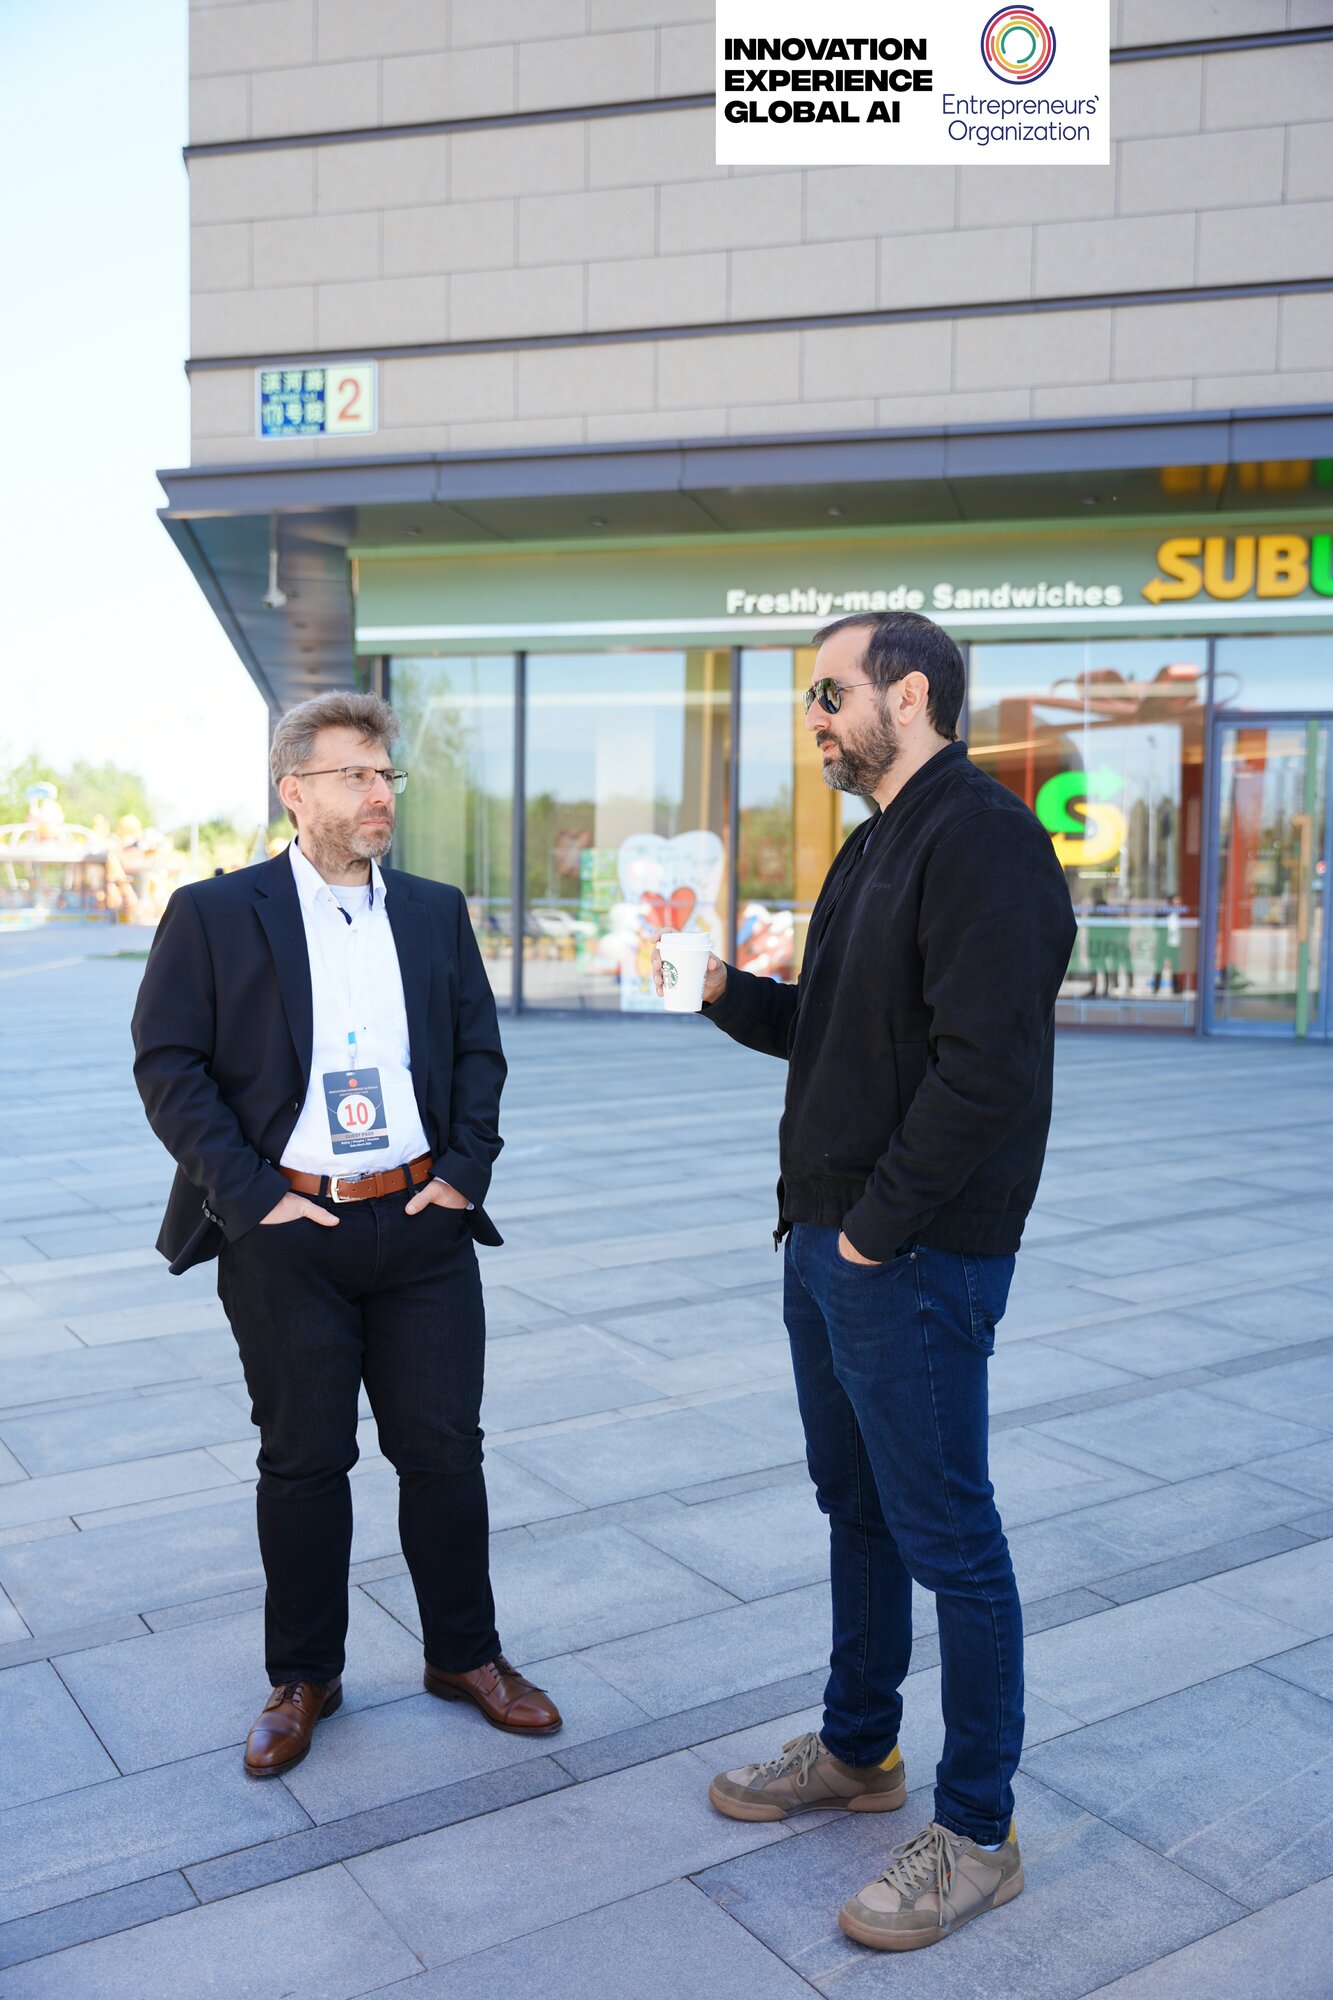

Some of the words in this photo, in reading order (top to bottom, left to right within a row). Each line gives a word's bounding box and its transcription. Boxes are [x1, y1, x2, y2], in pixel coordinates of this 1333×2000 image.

[338, 378, 361, 421] 2
[726, 585, 925, 617] Freshly-made
[932, 581, 1123, 613] Sandwiches
[344, 1102, 369, 1127] 10
